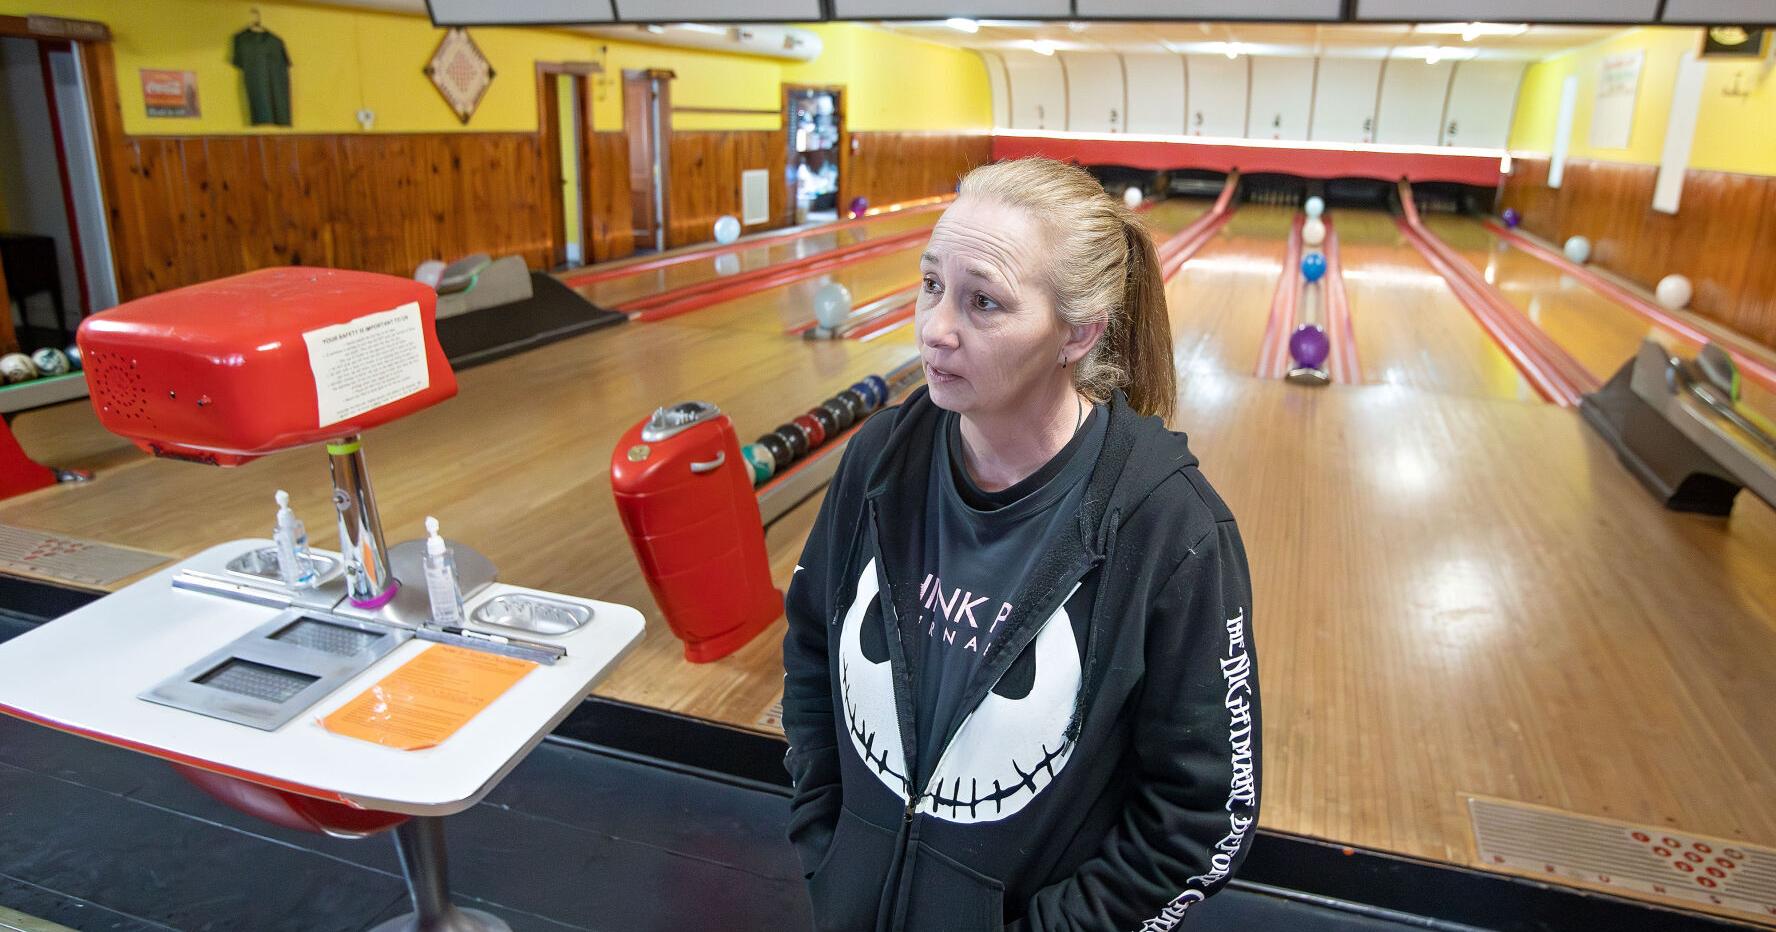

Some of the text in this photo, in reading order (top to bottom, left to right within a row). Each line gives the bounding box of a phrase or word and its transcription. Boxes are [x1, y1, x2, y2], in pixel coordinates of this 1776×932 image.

[339, 329, 358, 340] SAFETY
[365, 319, 394, 332] IMPORTANT
[918, 615, 992, 656] RNA
[1226, 607, 1245, 657] THE
[1220, 649, 1255, 812] NIGHTMARE
[1186, 812, 1252, 887] BEFORE
